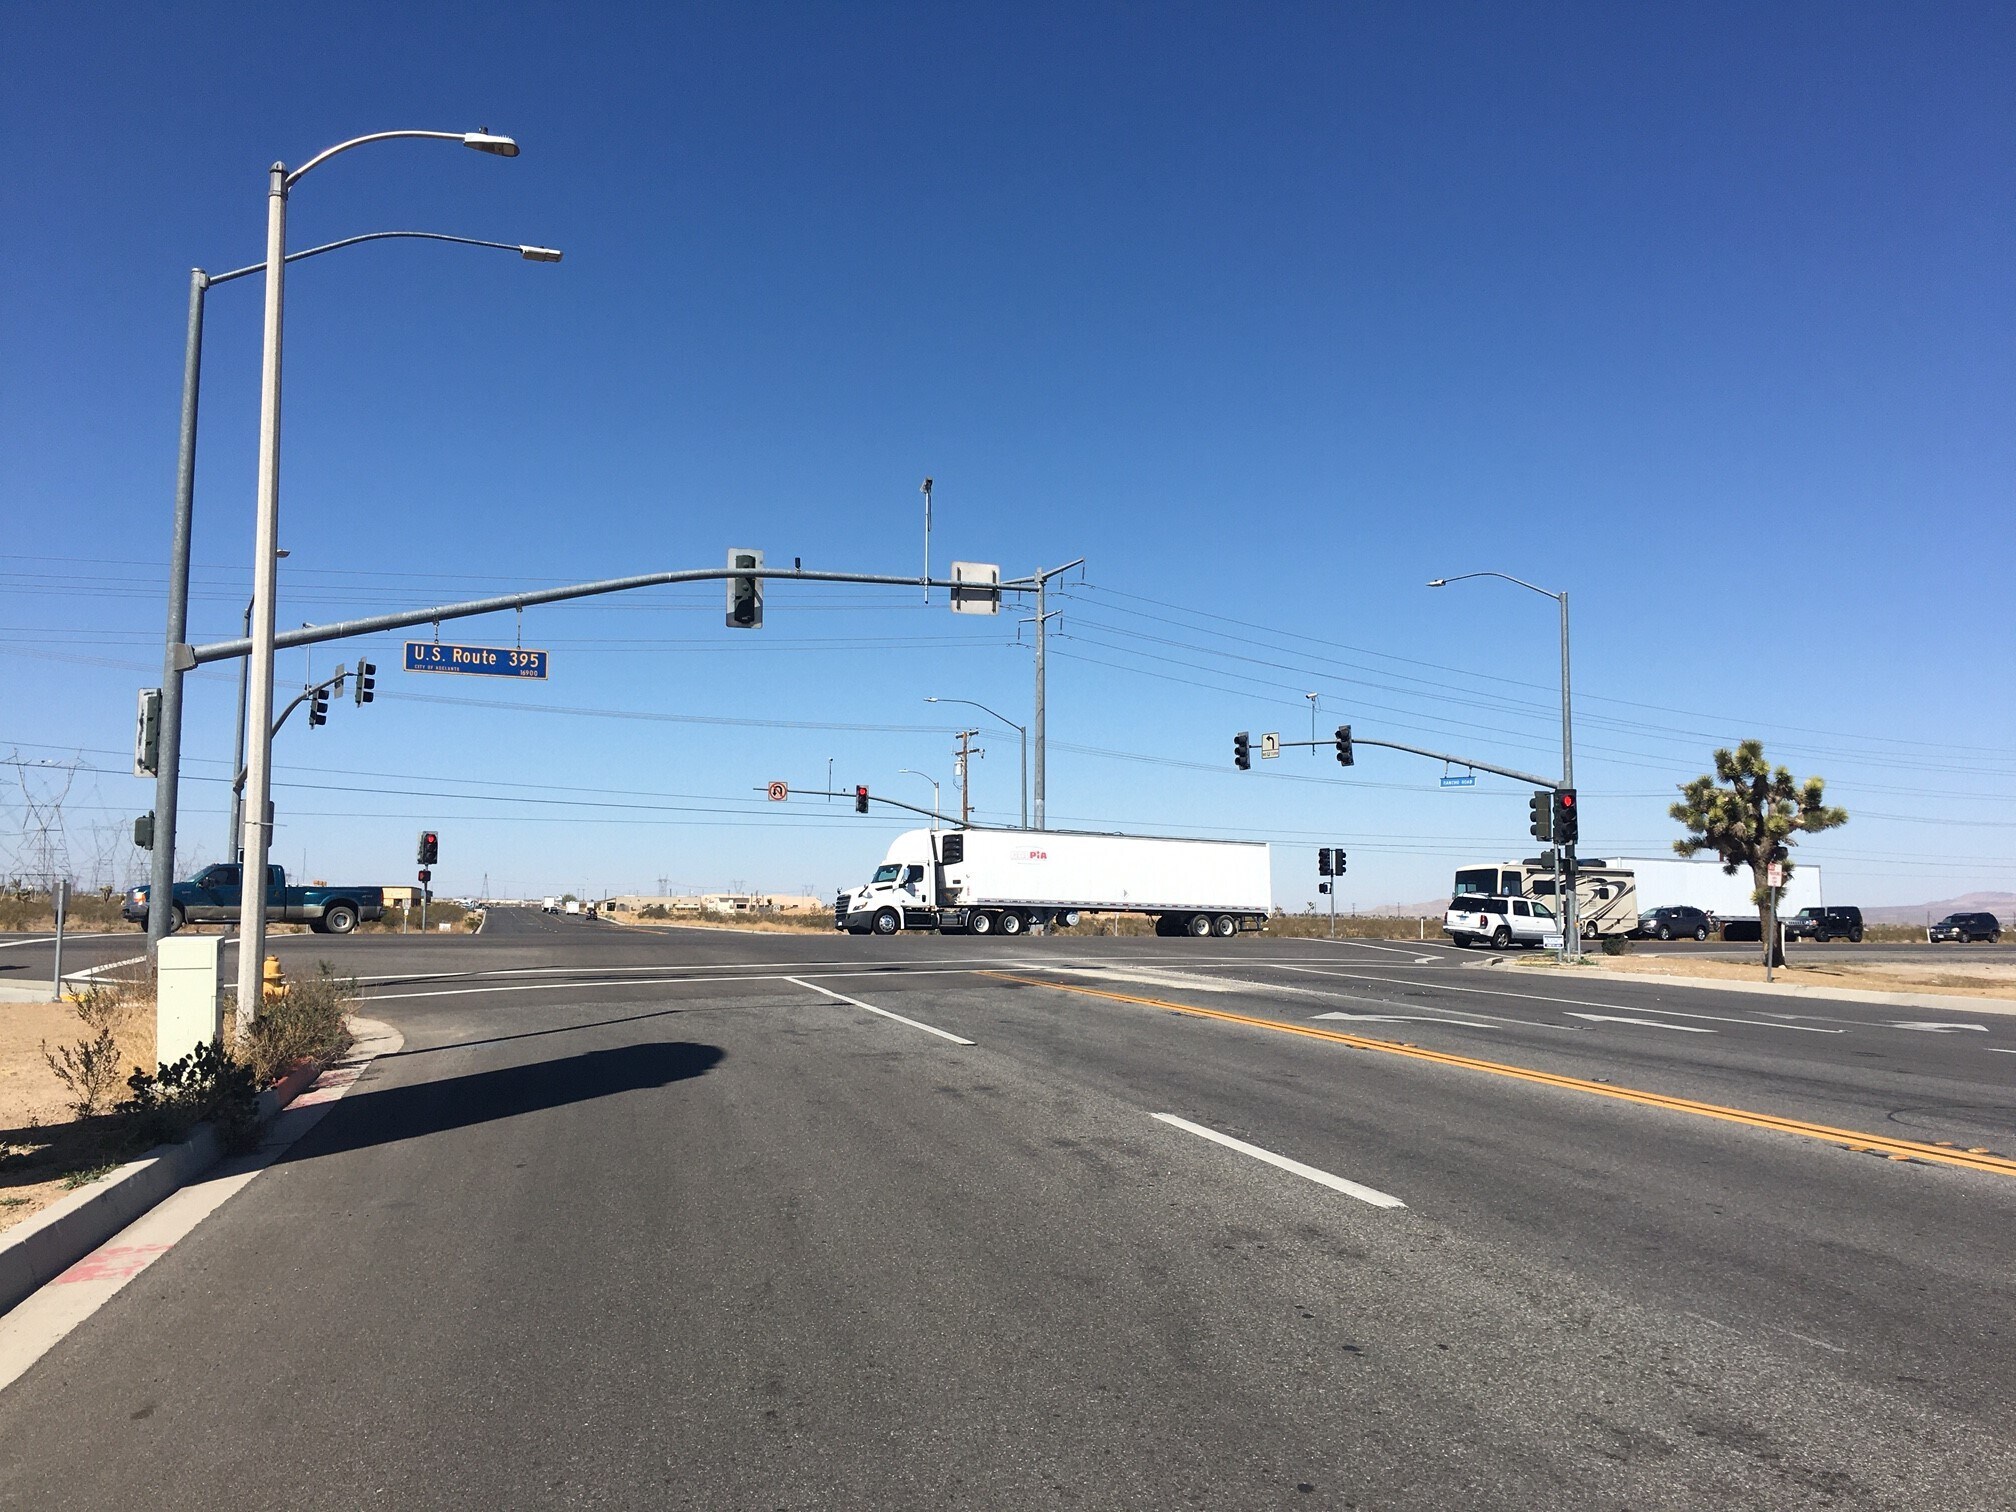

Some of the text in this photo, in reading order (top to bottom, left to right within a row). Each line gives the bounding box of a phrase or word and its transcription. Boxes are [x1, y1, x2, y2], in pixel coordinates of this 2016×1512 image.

[414, 646, 539, 668] U.S. Route 395
